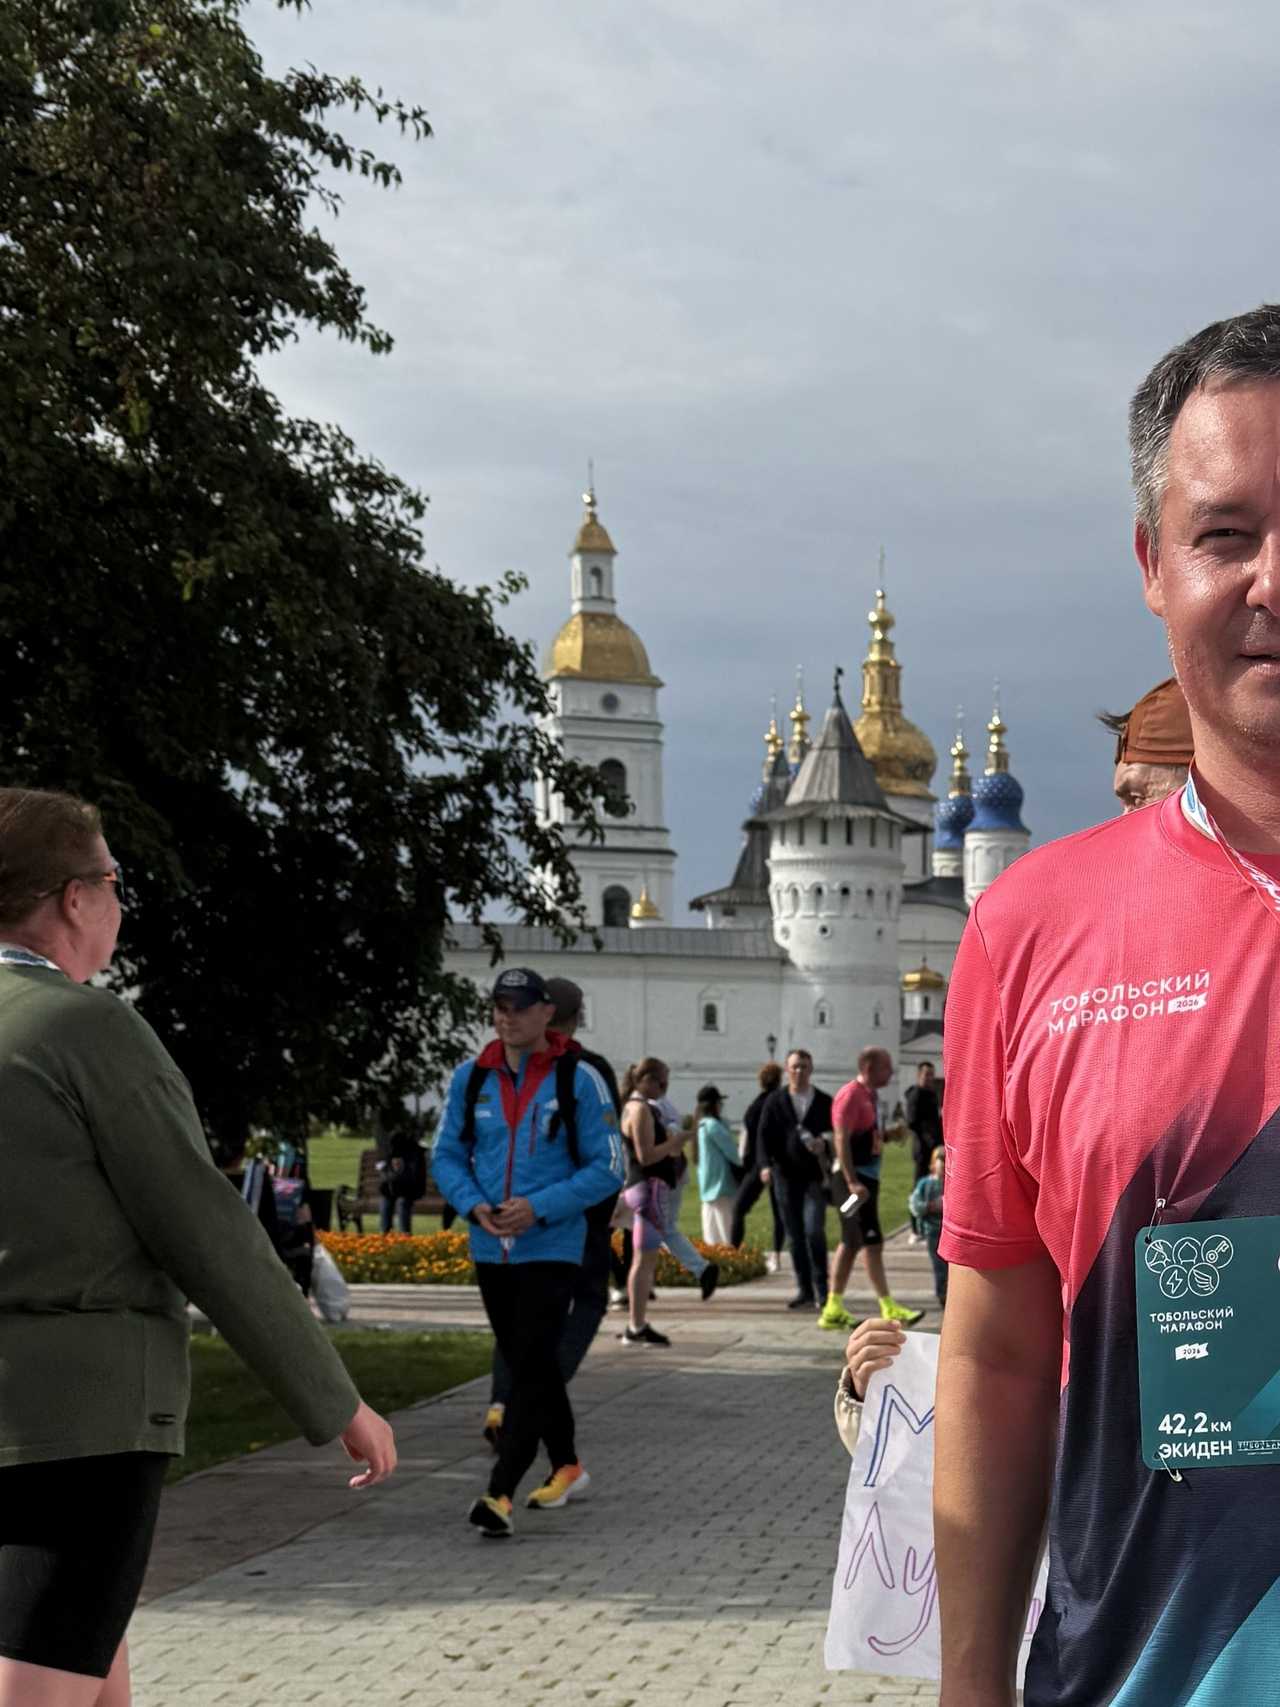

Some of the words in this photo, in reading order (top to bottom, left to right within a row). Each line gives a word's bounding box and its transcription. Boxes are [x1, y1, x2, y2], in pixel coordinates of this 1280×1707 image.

[1051, 969, 1210, 1015] ТОБОЛЬСКИЙ
[1048, 1000, 1164, 1038] МАРАФОН
[1150, 1305, 1234, 1323] ТОБОЛЬСКИЙ
[1160, 1320, 1223, 1334] МАРАФОН
[1158, 1412, 1209, 1437] 42,2
[1159, 1440, 1233, 1460] ЭКИДЕН
